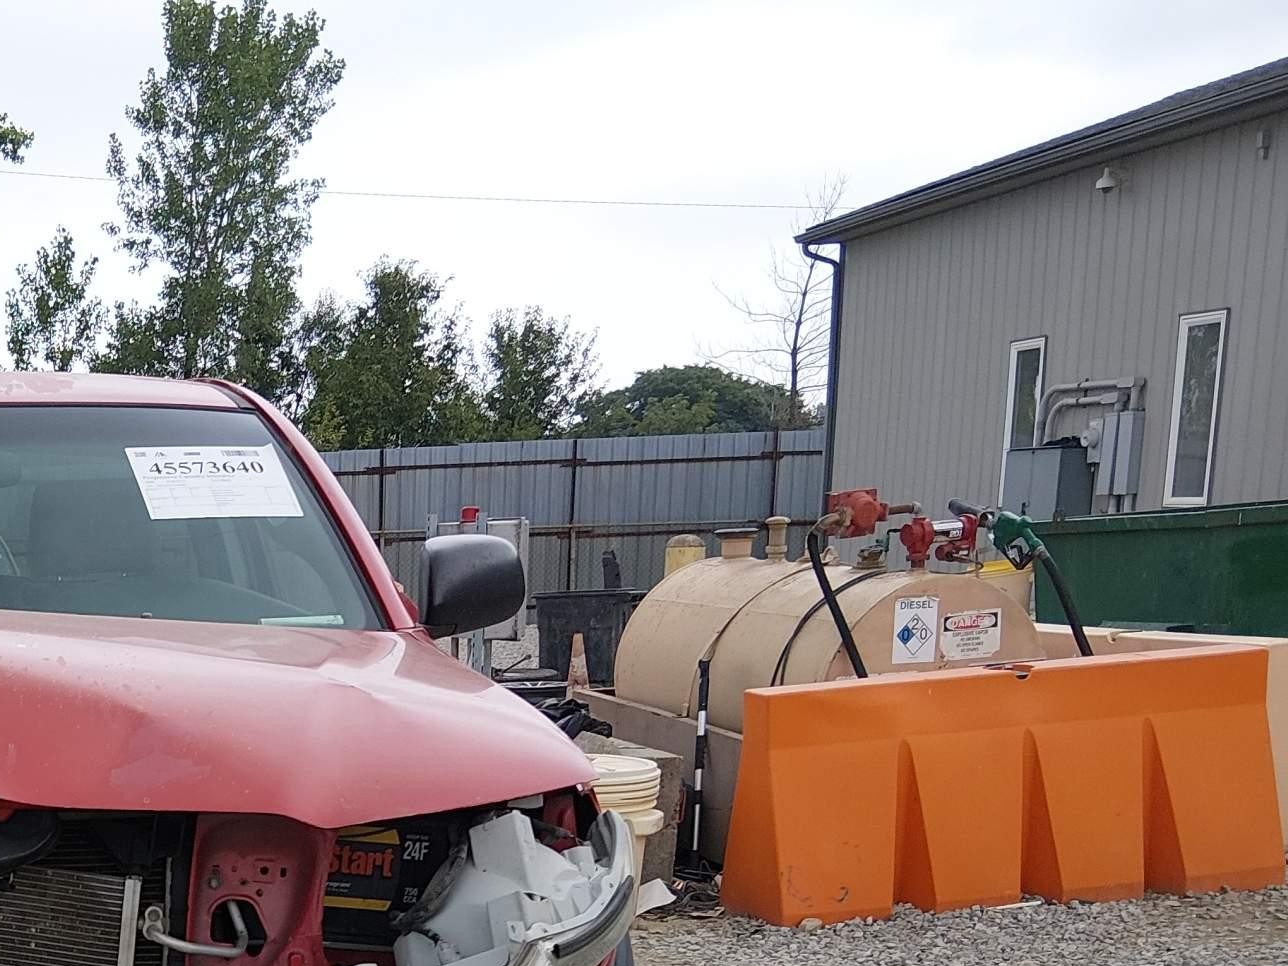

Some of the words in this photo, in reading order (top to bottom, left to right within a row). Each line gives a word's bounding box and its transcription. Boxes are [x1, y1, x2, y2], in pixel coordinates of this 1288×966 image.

[149, 461, 264, 475] 45573640
[900, 600, 933, 610] DIESEL
[911, 617, 920, 630] 2
[901, 628, 911, 642] 0
[919, 627, 928, 641] 0
[402, 840, 430, 861] 24F
